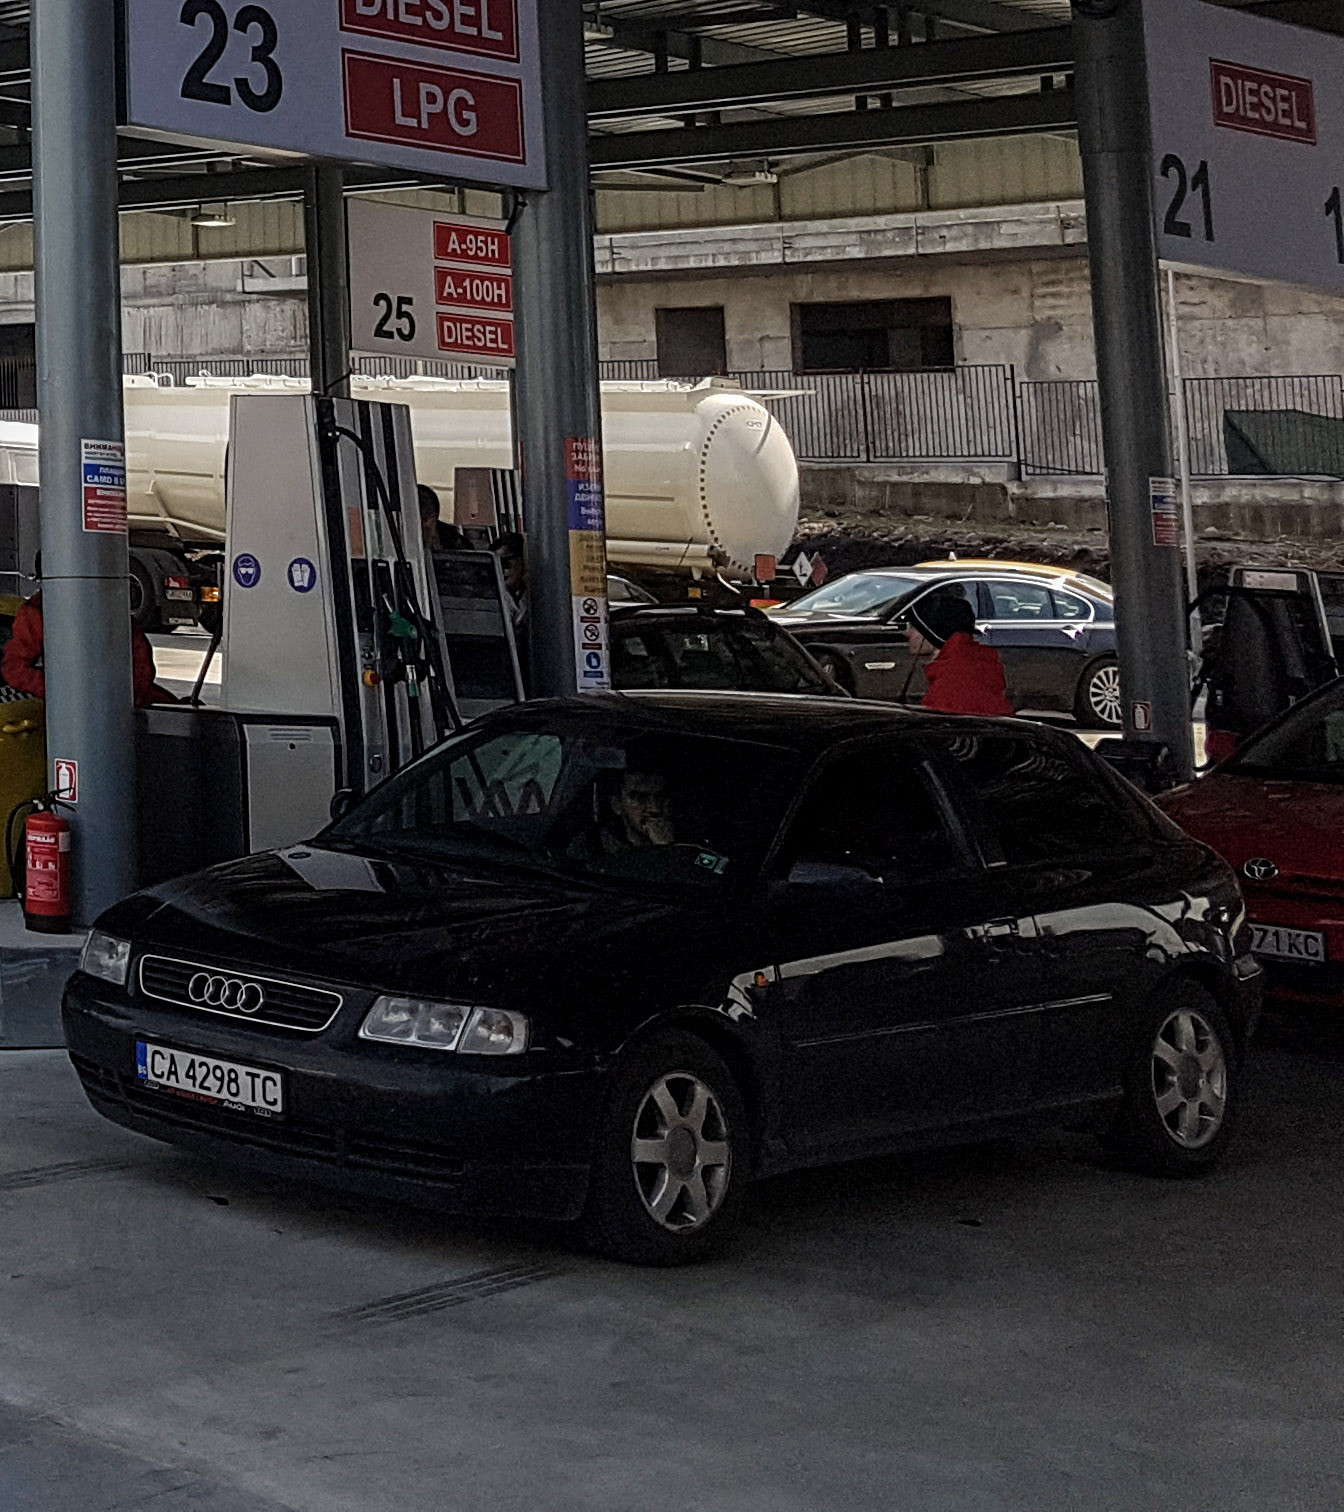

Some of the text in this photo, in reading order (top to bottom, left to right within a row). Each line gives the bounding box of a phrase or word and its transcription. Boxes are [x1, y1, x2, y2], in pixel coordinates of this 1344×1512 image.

[393, 78, 477, 136] LPG
[1219, 75, 1307, 130] DIESEL
[1160, 154, 1215, 242] 21
[447, 234, 499, 260] A-95H
[442, 277, 507, 304] A-100H
[373, 292, 416, 343] 25
[442, 322, 509, 349] DIESEL
[1248, 926, 1281, 952] 71
[151, 1050, 179, 1084] CA
[185, 1058, 240, 1097] 4298
[245, 1071, 278, 1106] TC
